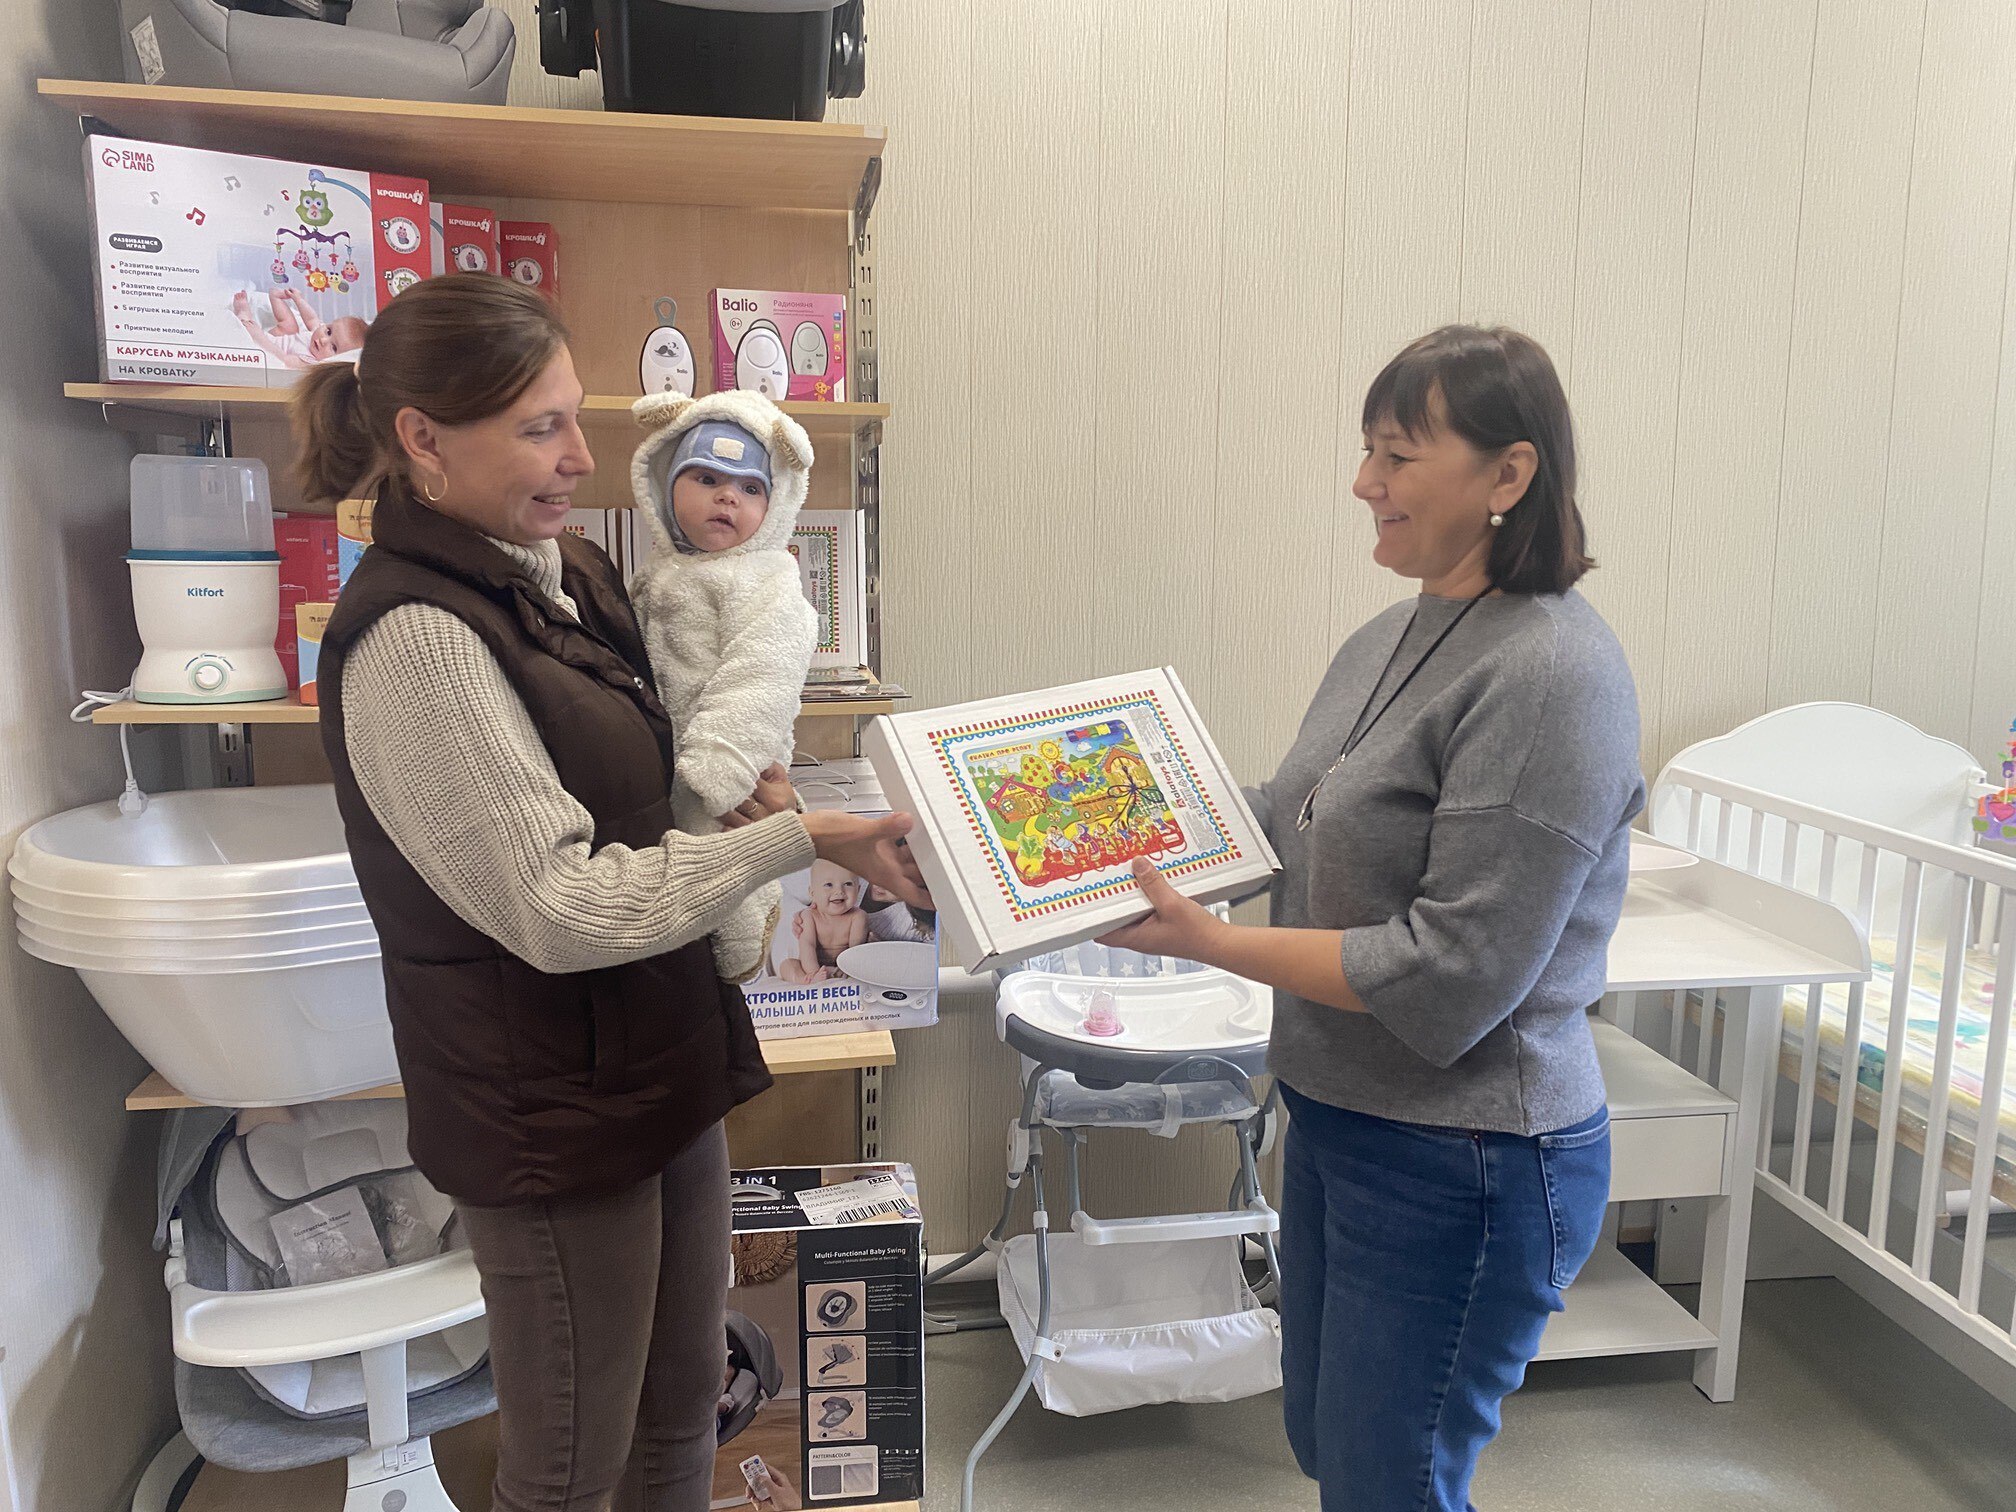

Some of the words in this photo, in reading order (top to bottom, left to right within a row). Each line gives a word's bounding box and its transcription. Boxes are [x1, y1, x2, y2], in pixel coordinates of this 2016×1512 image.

[122, 150, 153, 163] SIMA
[123, 160, 154, 172] LAND
[113, 236, 158, 246] РАЗВИВАЕМСЯ
[119, 260, 154, 270] Развитие
[155, 264, 200, 275] визуального
[119, 269, 162, 277] восприятия
[120, 281, 155, 291] Развитие
[156, 286, 193, 294] слухового
[121, 290, 164, 298] восприятия
[722, 297, 758, 312] Balio
[773, 299, 814, 309] Радионяня
[128, 306, 160, 314] игрушек
[171, 309, 205, 317] карусели
[124, 324, 161, 333] Приятные
[162, 326, 194, 335] мелодии
[116, 346, 174, 358] КАРУСЕЛЬ
[177, 350, 260, 363] МУЗЫКАЛЬНАЯ
[118, 365, 136, 375] НА
[139, 366, 197, 378] КРОВАТКУ
[187, 587, 224, 597] Kitfort
[996, 748, 1010, 756] ПРО
[745, 988, 818, 1005] КТРОННЫЕ
[822, 985, 860, 999] ВЕСЫ
[750, 1004, 804, 1019] АЛЫША
[809, 1004, 817, 1014] И
[821, 1000, 861, 1013] МАМЫ
[754, 1023, 780, 1032] онтроле
[797, 1020, 810, 1028] для
[811, 1016, 863, 1027] новорожденных
[871, 1013, 901, 1021] взрослых
[768, 1175, 777, 1185] 1
[762, 1204, 780, 1212] Baby
[814, 1249, 869, 1260] Multi-Functional
[869, 1247, 886, 1256] Baby
[887, 1246, 906, 1256] Swing
